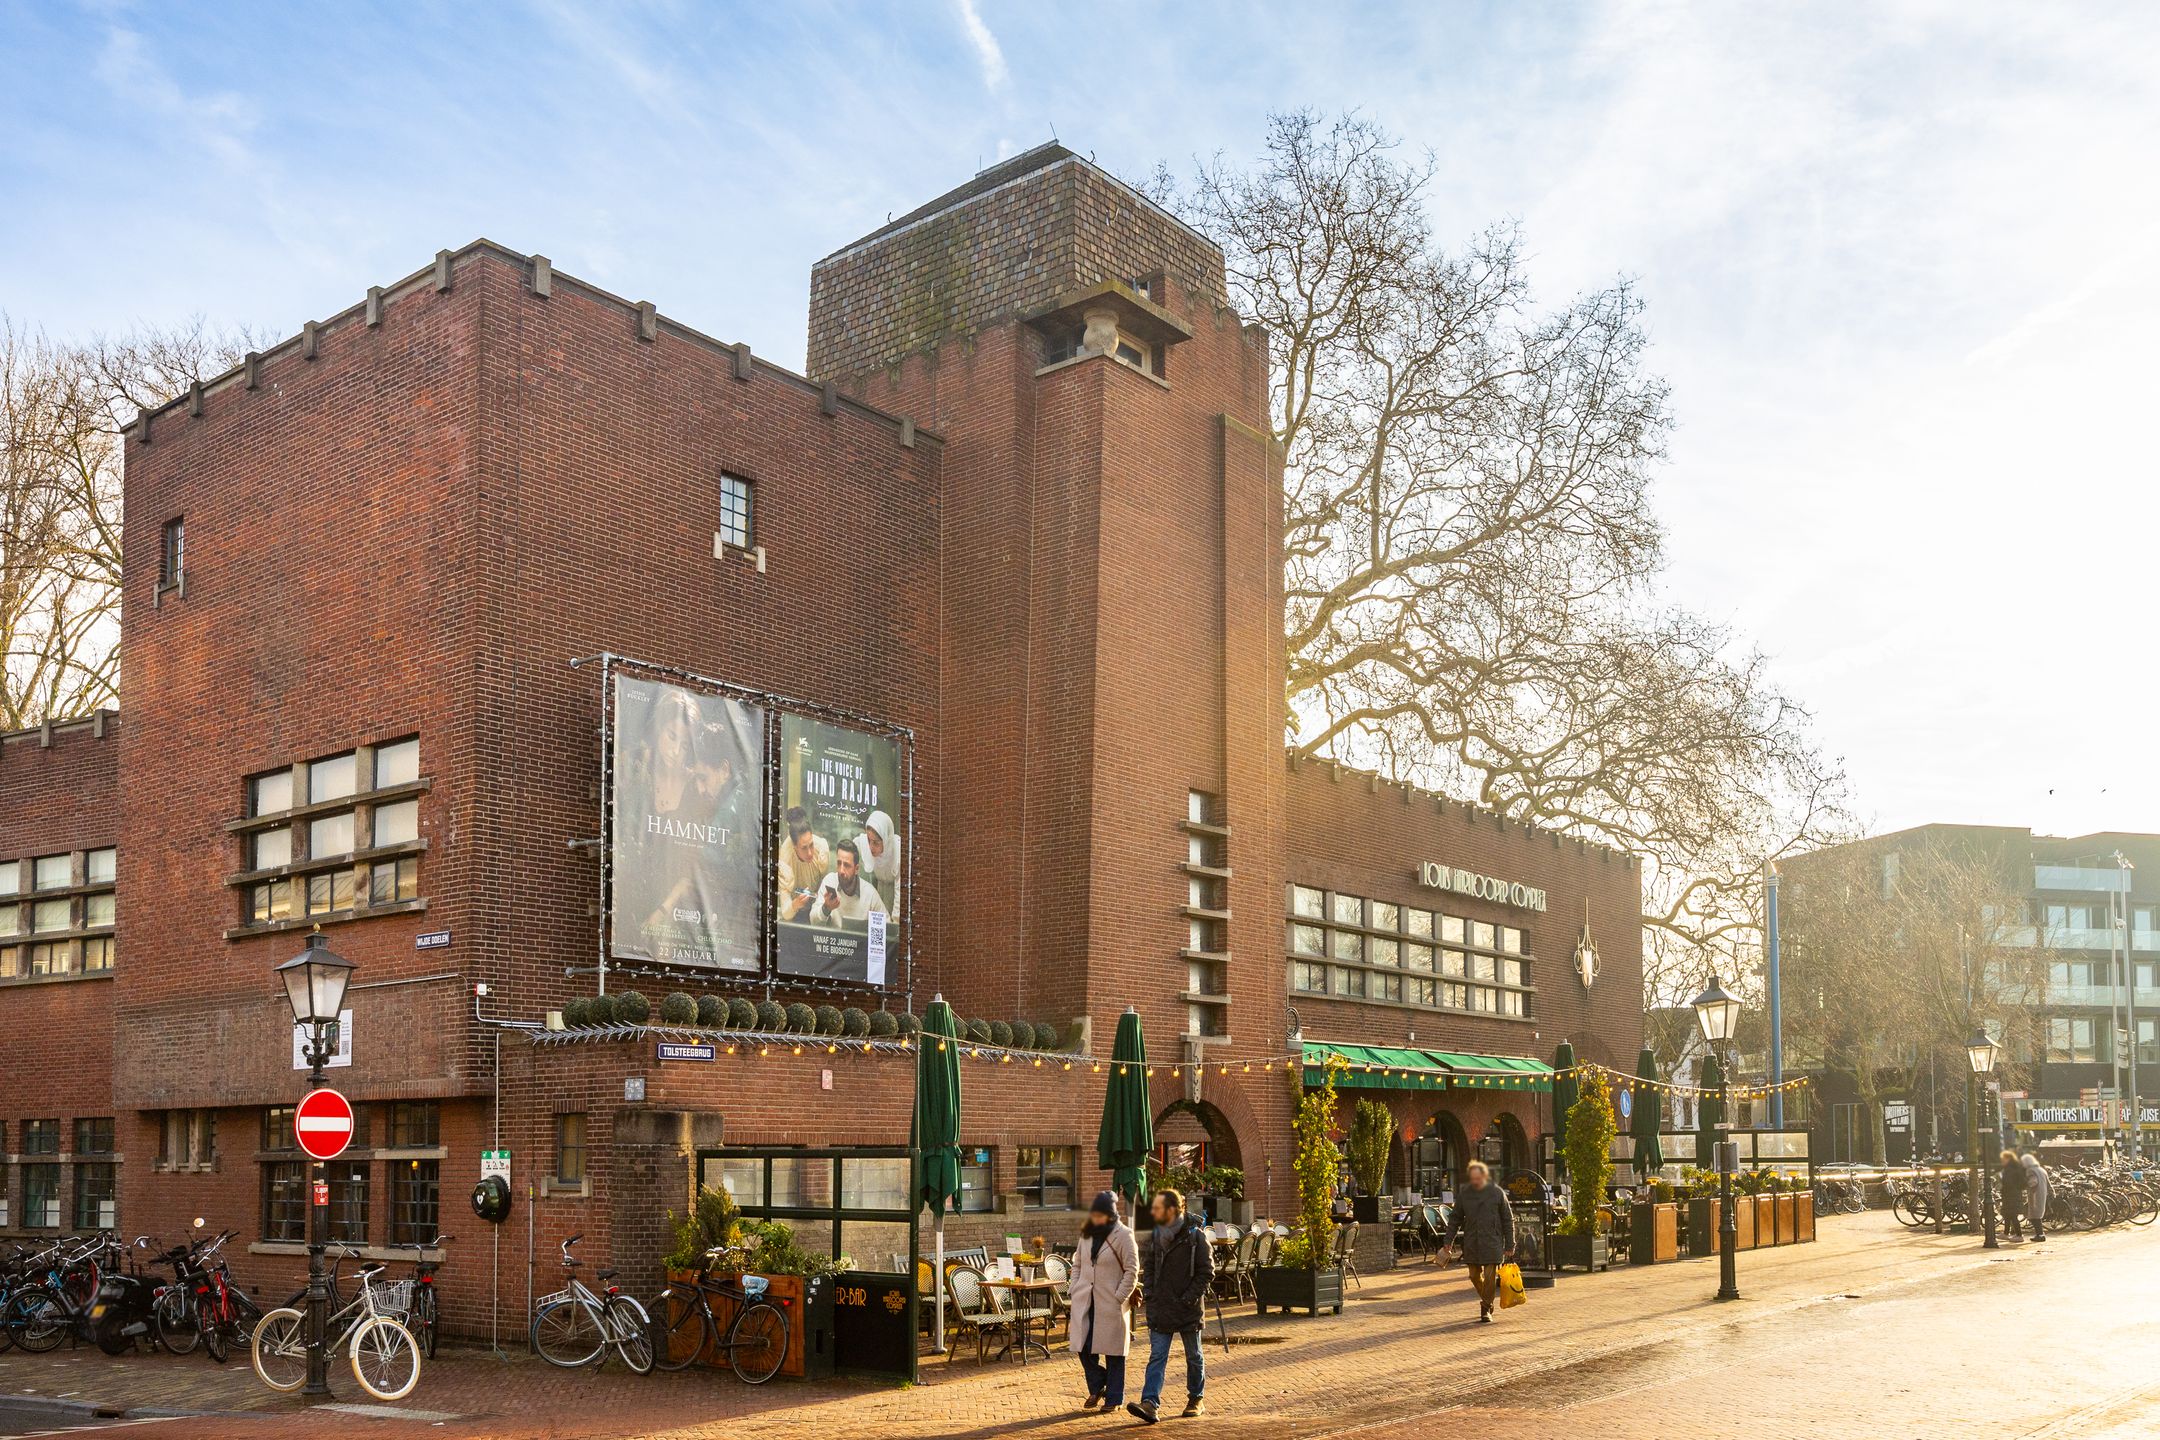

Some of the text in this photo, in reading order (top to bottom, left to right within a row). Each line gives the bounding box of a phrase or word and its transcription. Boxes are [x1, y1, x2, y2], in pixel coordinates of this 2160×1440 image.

[821, 758, 863, 780] THE VOICE OF
[807, 770, 878, 806] HIND RAJAB
[647, 814, 730, 845] HAMNET
[1423, 860, 1451, 890] LOUIS
[1511, 882, 1547, 912] COMPLEX
[431, 934, 449, 945] DOELEN
[813, 935, 858, 948] VANAF 22 JANUARI
[659, 947, 669, 956] 22
[672, 949, 717, 960] JANUARI
[815, 944, 855, 956] IN DE BIOSCOOP
[662, 1046, 712, 1058] TOLSTEEGBRUG
[2032, 1106, 2077, 1122] BROTHERS
[2080, 1108, 2090, 1122] IN
